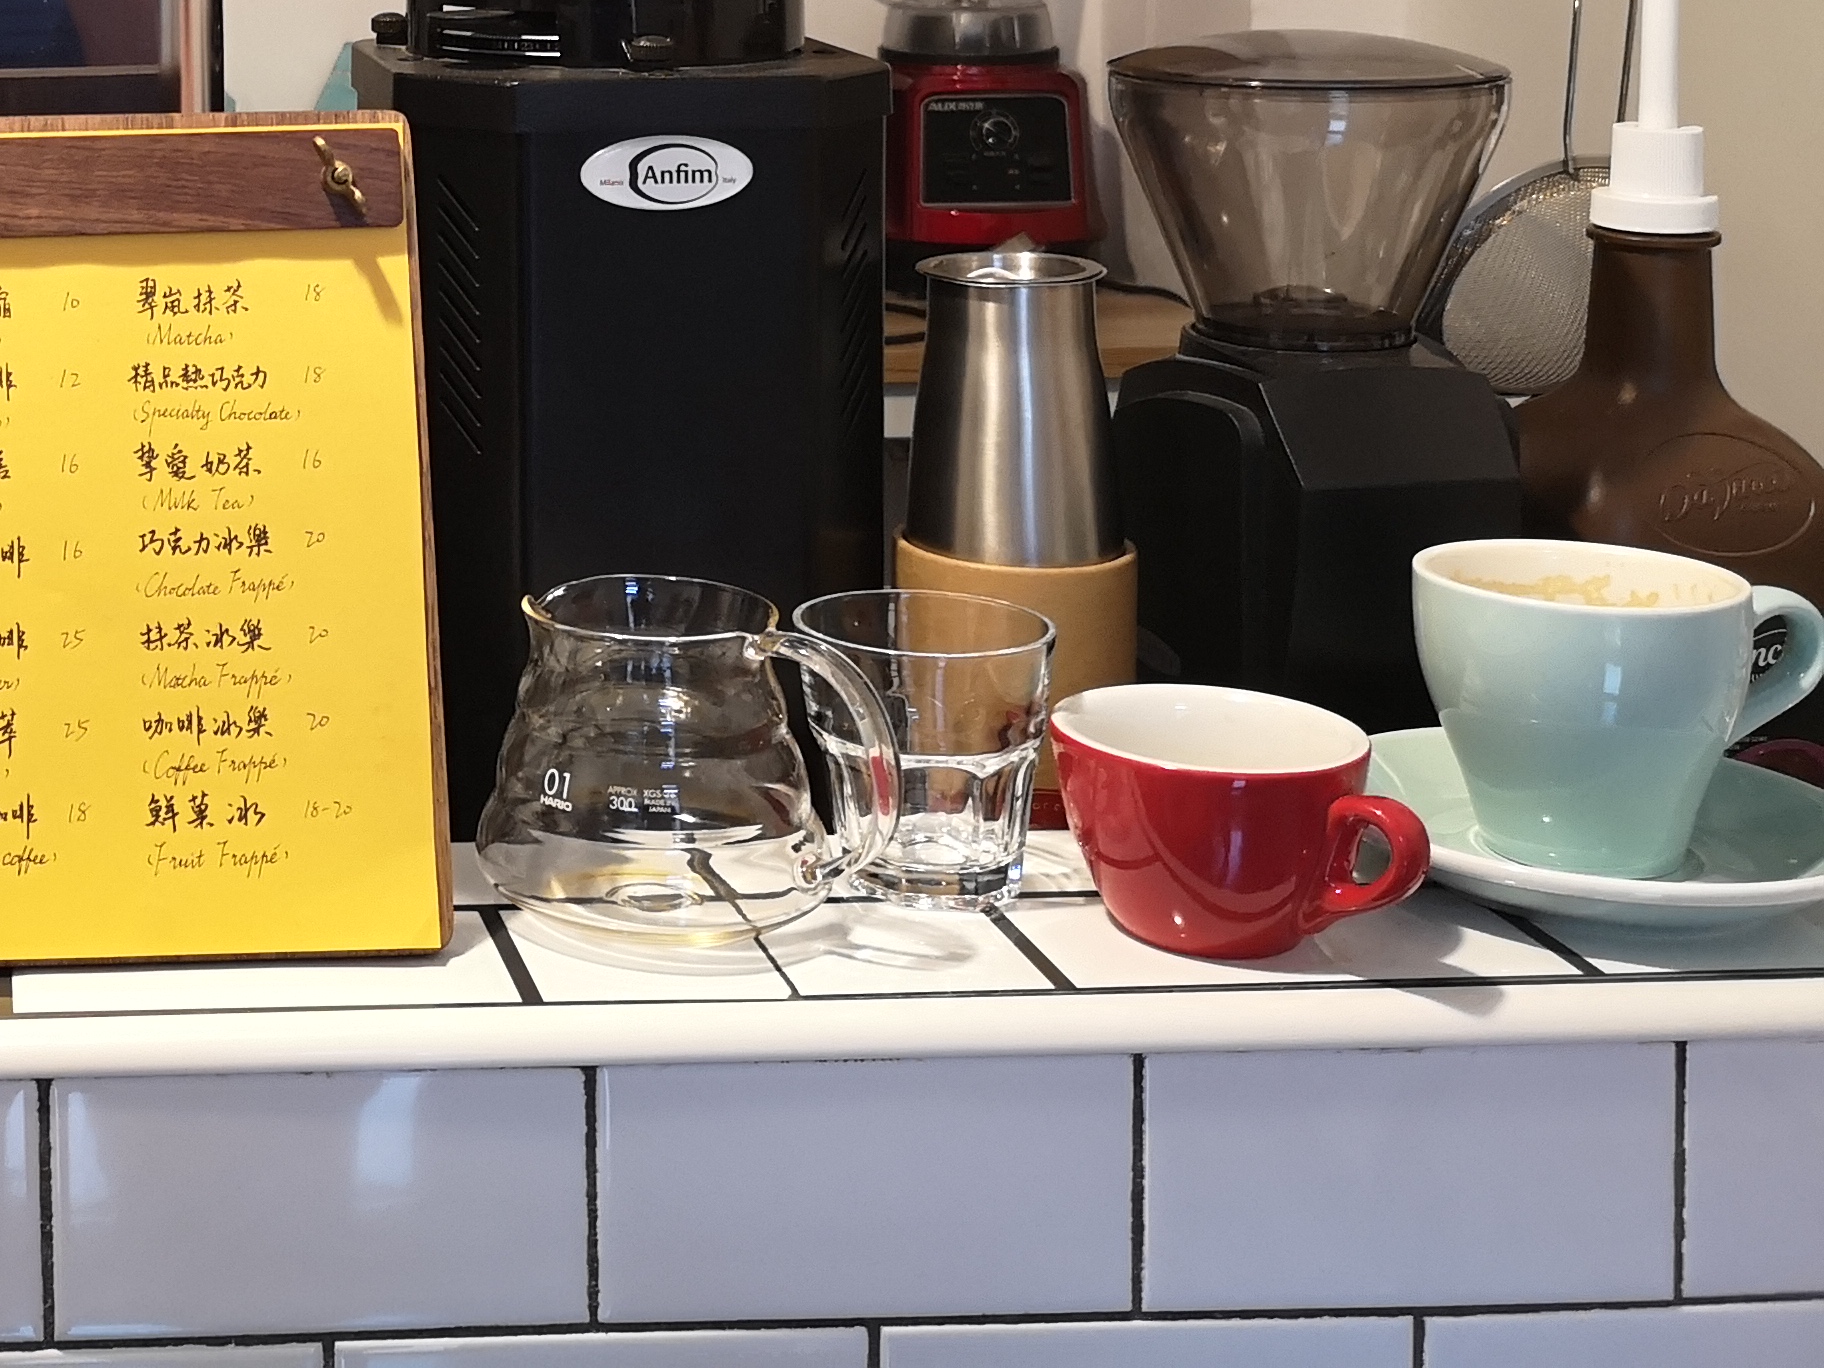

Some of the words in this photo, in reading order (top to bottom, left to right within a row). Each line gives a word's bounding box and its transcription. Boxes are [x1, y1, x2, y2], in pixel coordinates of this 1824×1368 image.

[642, 163, 713, 185] Anfim
[62, 291, 80, 312] 10
[304, 283, 326, 302] 18
[59, 368, 82, 389] 12
[304, 365, 327, 384] 18
[61, 453, 79, 474] 16
[302, 448, 322, 470] 16
[304, 530, 326, 549] 20
[62, 539, 83, 562] 16
[60, 628, 86, 650] 25
[308, 625, 329, 645] 20
[63, 718, 91, 743] 25
[305, 711, 330, 732] 20
[543, 767, 572, 800] 01
[607, 785, 638, 797] APPROX
[68, 801, 92, 824] 18
[304, 799, 353, 820] 18-20
[539, 793, 573, 812] HARIO
[608, 795, 636, 811] 300
